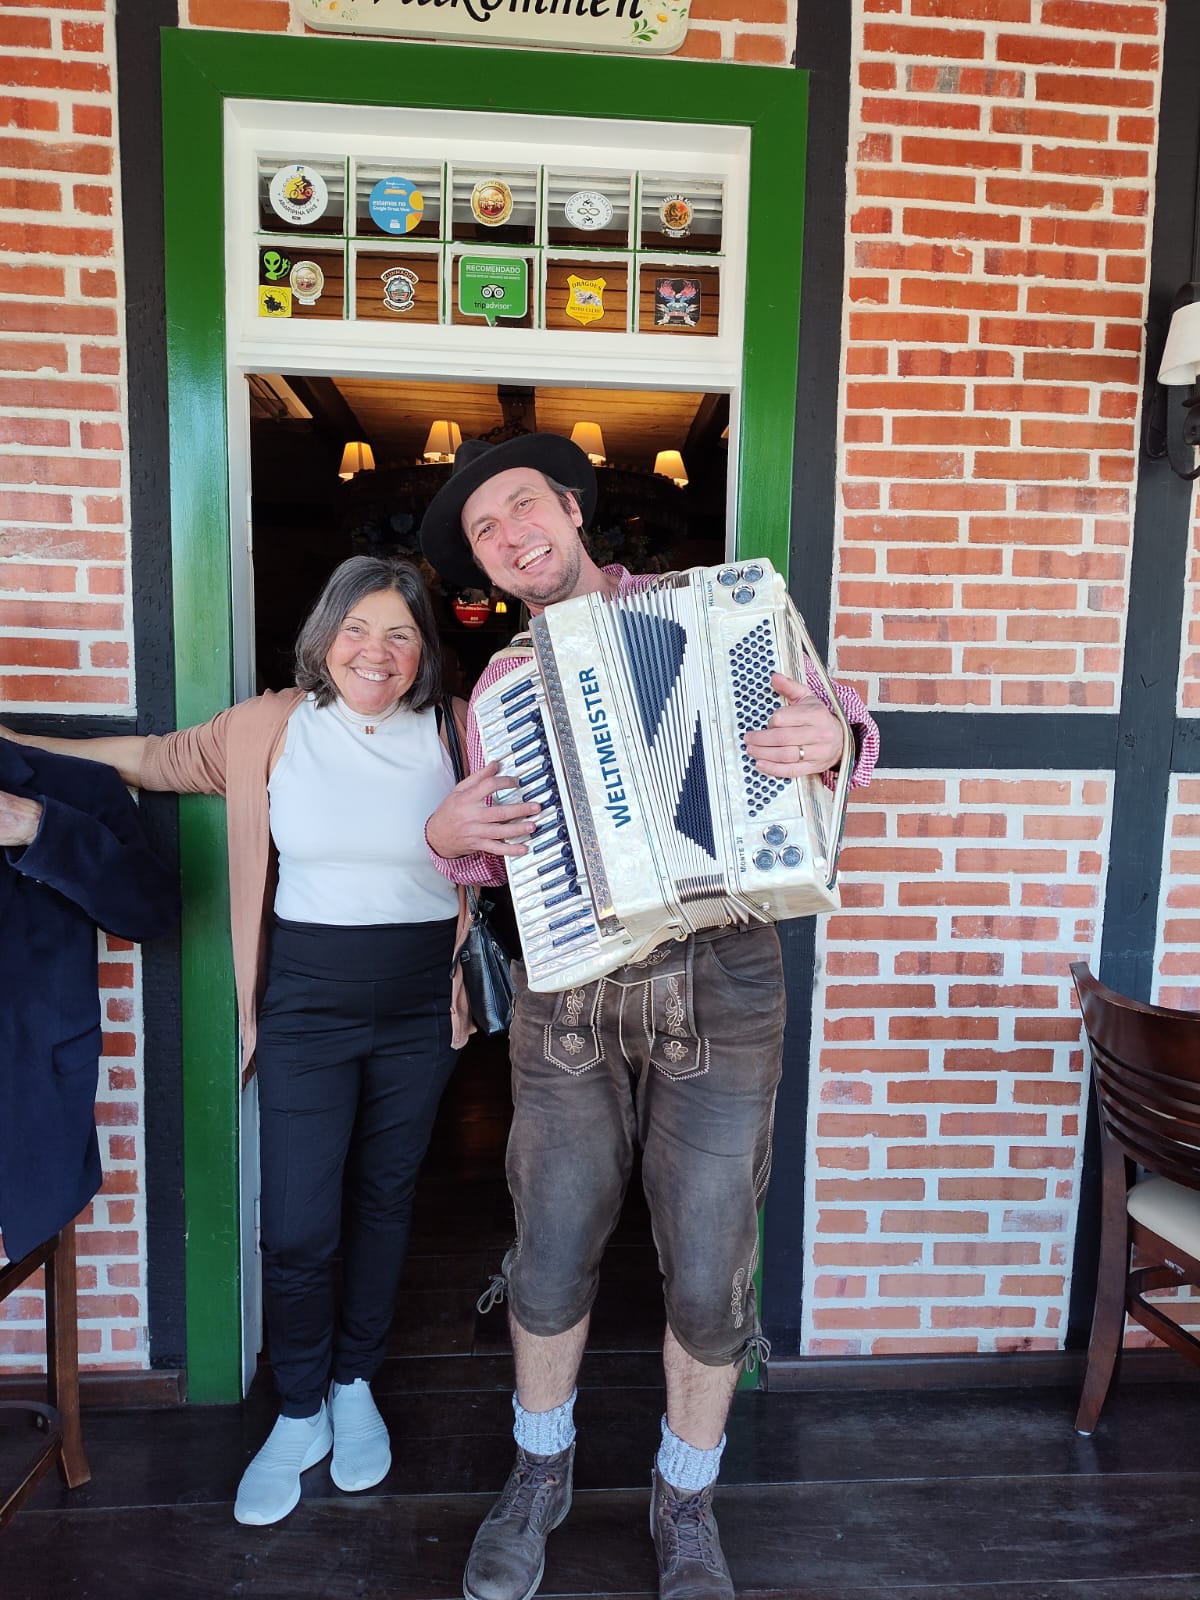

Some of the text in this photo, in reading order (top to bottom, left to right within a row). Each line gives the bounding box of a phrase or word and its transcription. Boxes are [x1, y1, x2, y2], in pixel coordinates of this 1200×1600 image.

[465, 264, 521, 274] RECOMENDADO
[473, 301, 511, 310] tripadvisor
[579, 667, 632, 828] WELTMEISTER
[736, 836, 747, 873] MONTE 37
